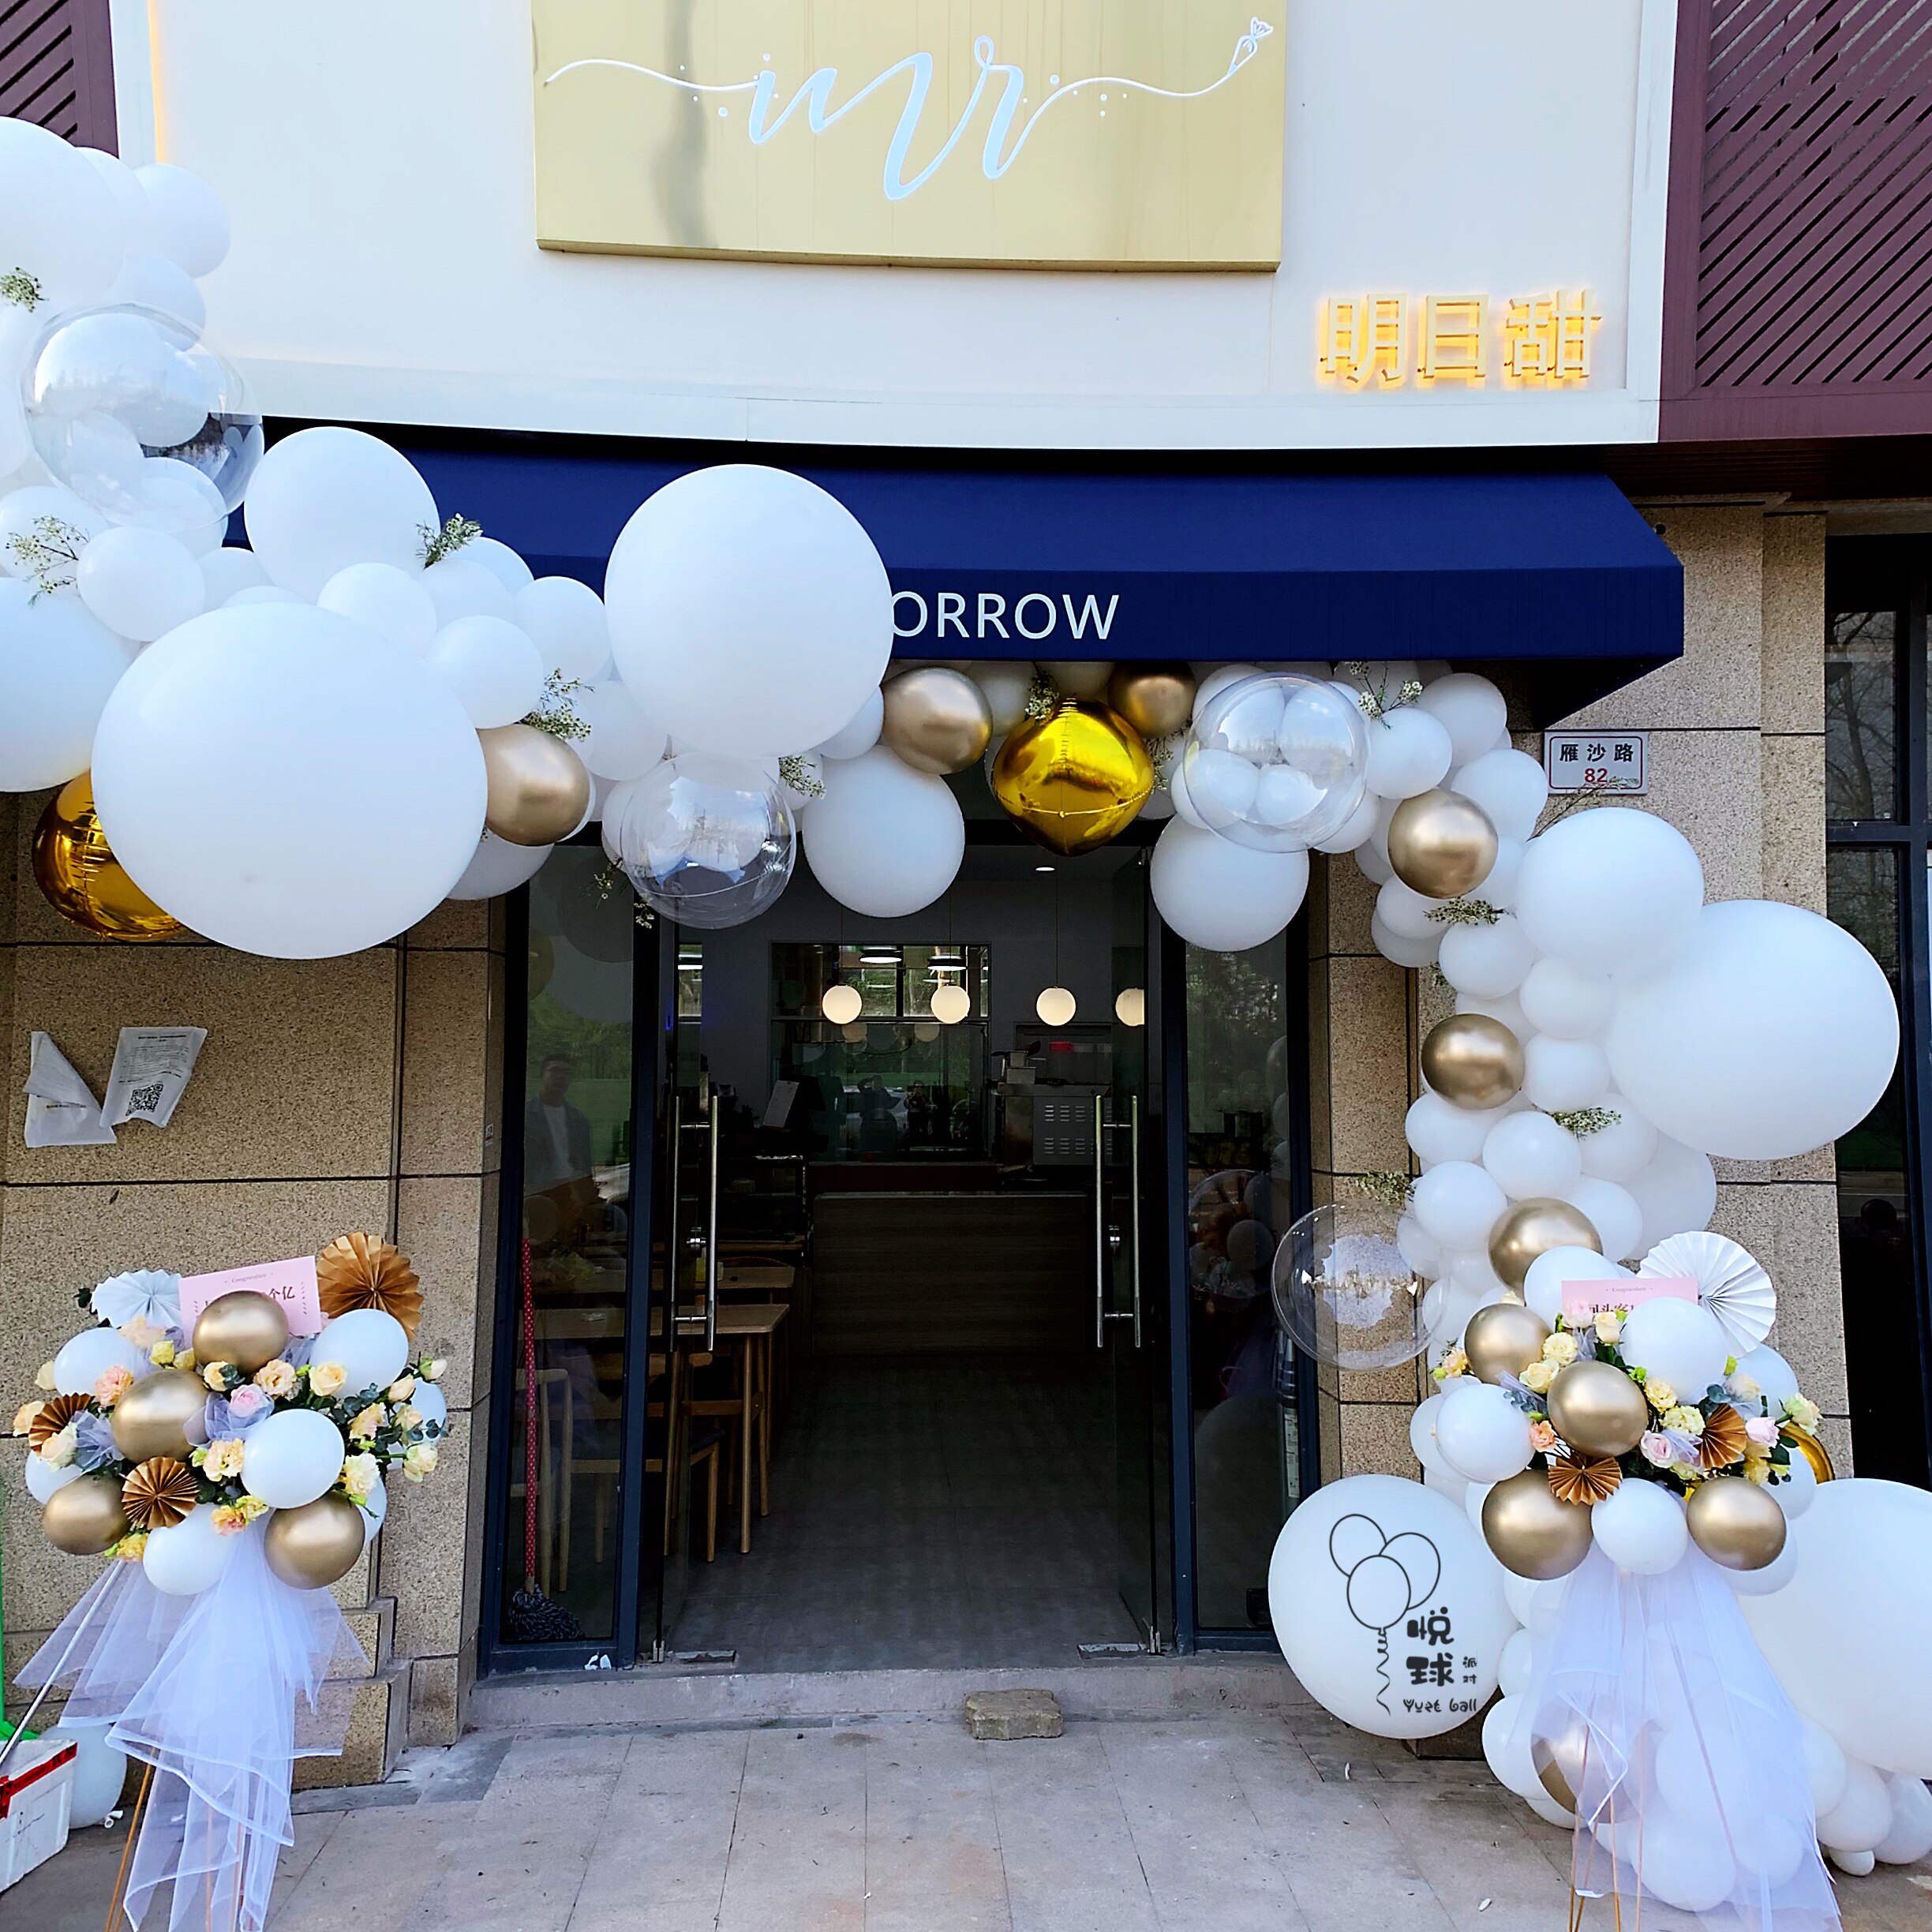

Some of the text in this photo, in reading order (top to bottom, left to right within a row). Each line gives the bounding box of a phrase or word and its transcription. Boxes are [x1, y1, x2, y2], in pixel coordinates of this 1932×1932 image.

[1324, 289, 1602, 383] 明日甜
[1559, 743, 1634, 762] 雁沙路
[1585, 768, 1608, 783] 82
